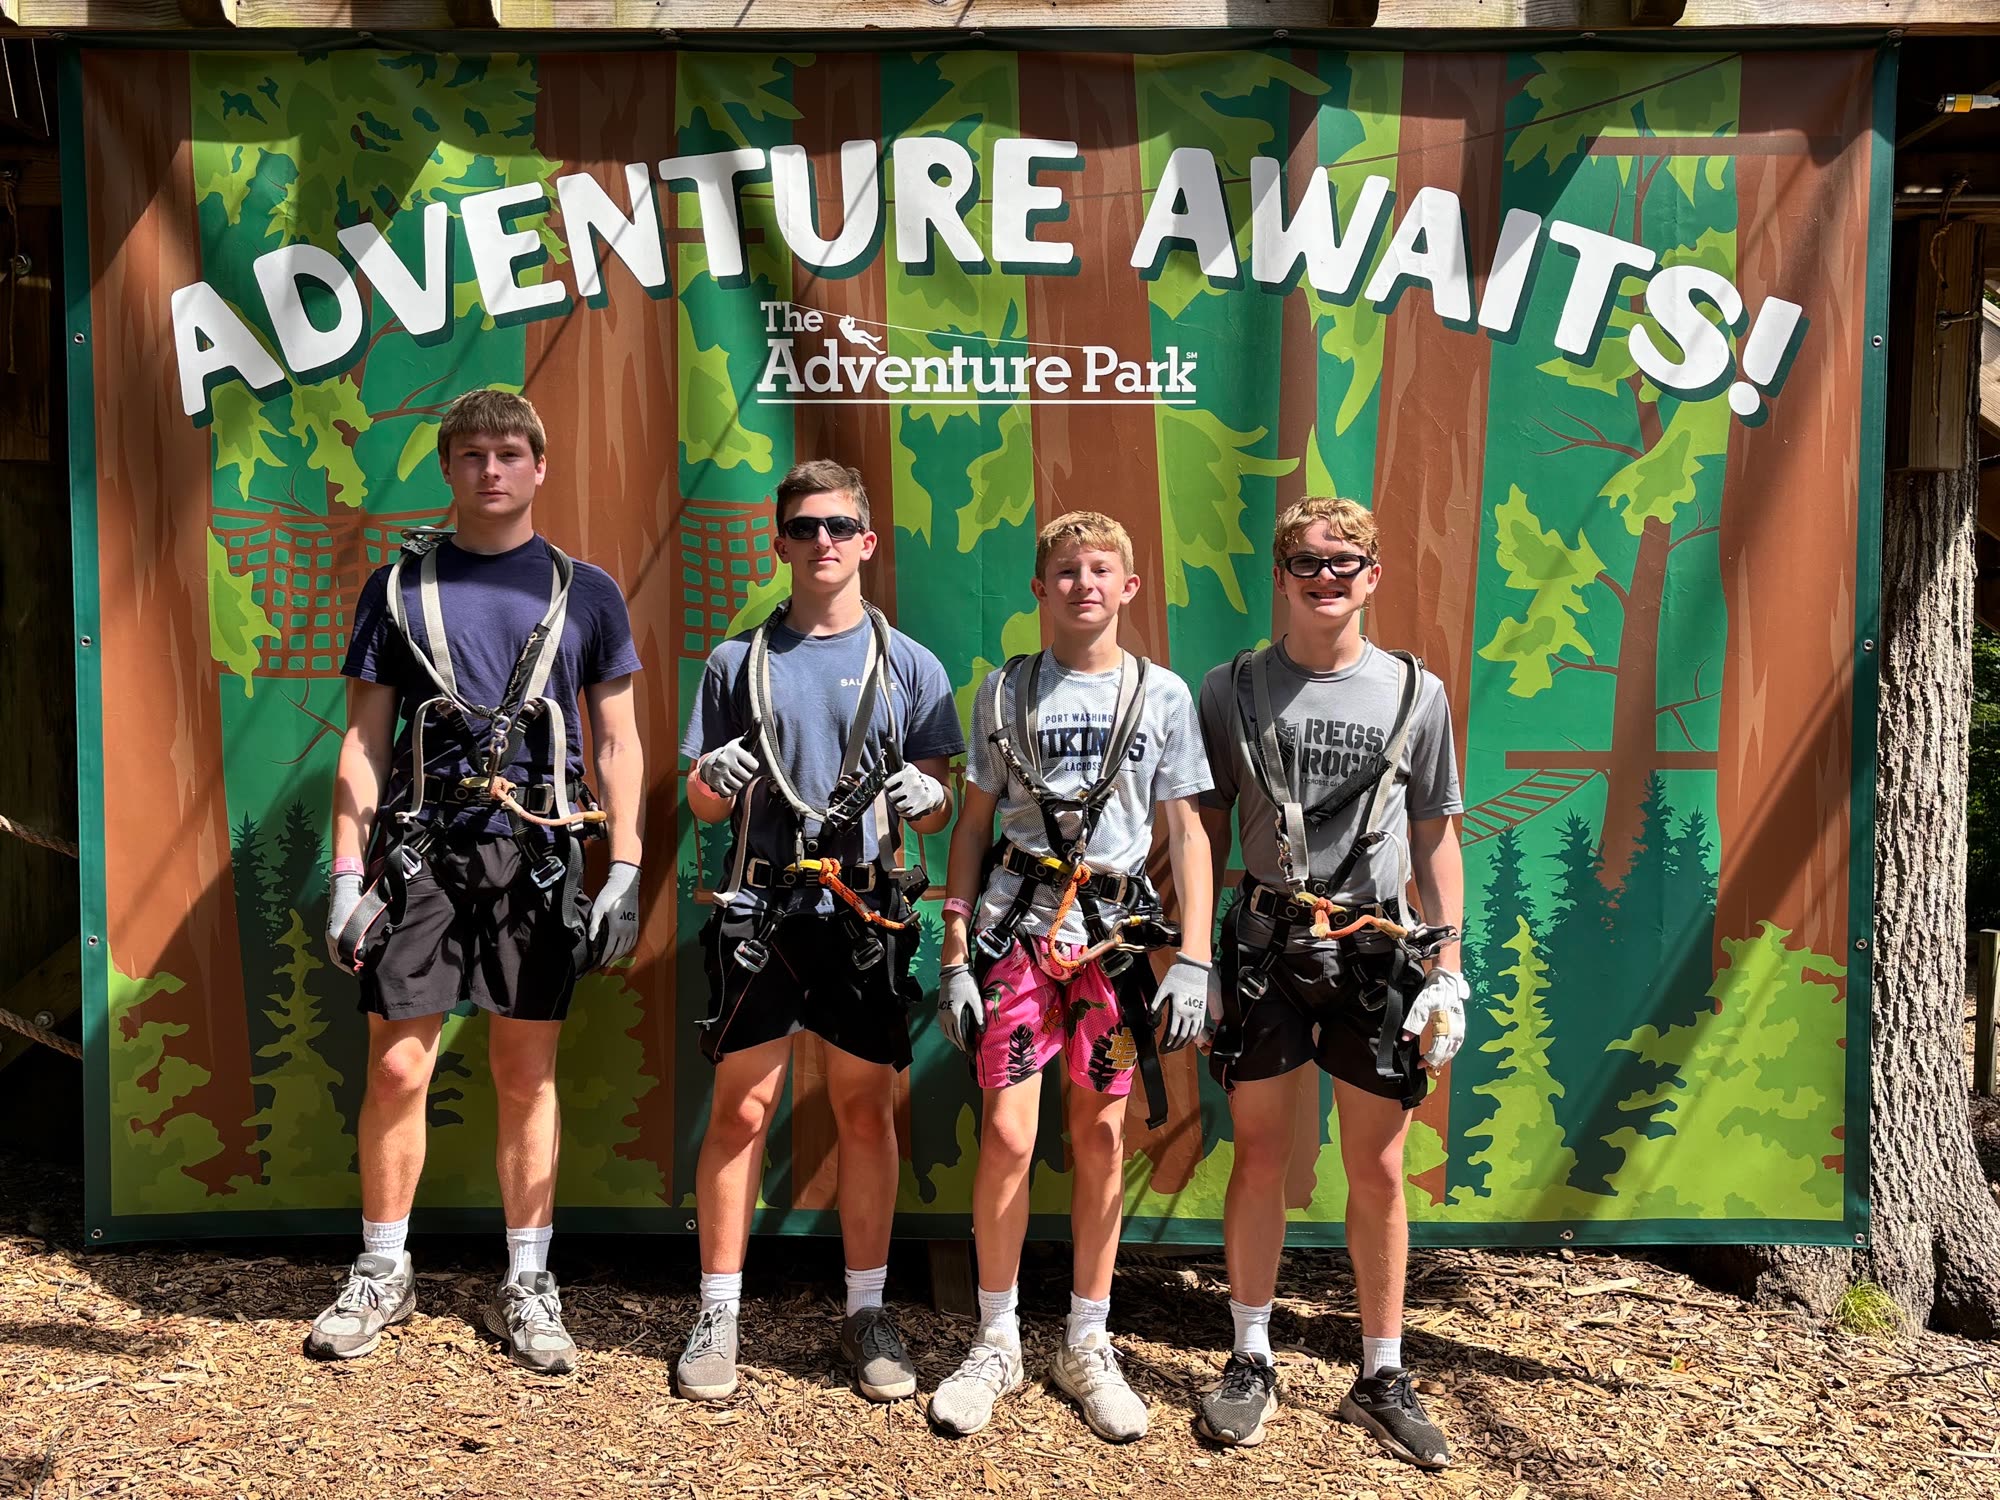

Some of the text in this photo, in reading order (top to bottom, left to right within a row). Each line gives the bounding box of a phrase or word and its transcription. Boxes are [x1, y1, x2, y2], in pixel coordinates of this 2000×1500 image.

[170, 135, 1804, 420] ADVENTURE AWAITS!
[760, 300, 824, 333] The
[757, 337, 1072, 394] Adventure
[1081, 345, 1197, 394] Park
[1045, 712, 1114, 724] PORT WASHING
[1304, 718, 1385, 753] REGS
[1065, 761, 1102, 772] LACROSS
[619, 910, 636, 921] ACE
[1183, 996, 1205, 1010] ACE
